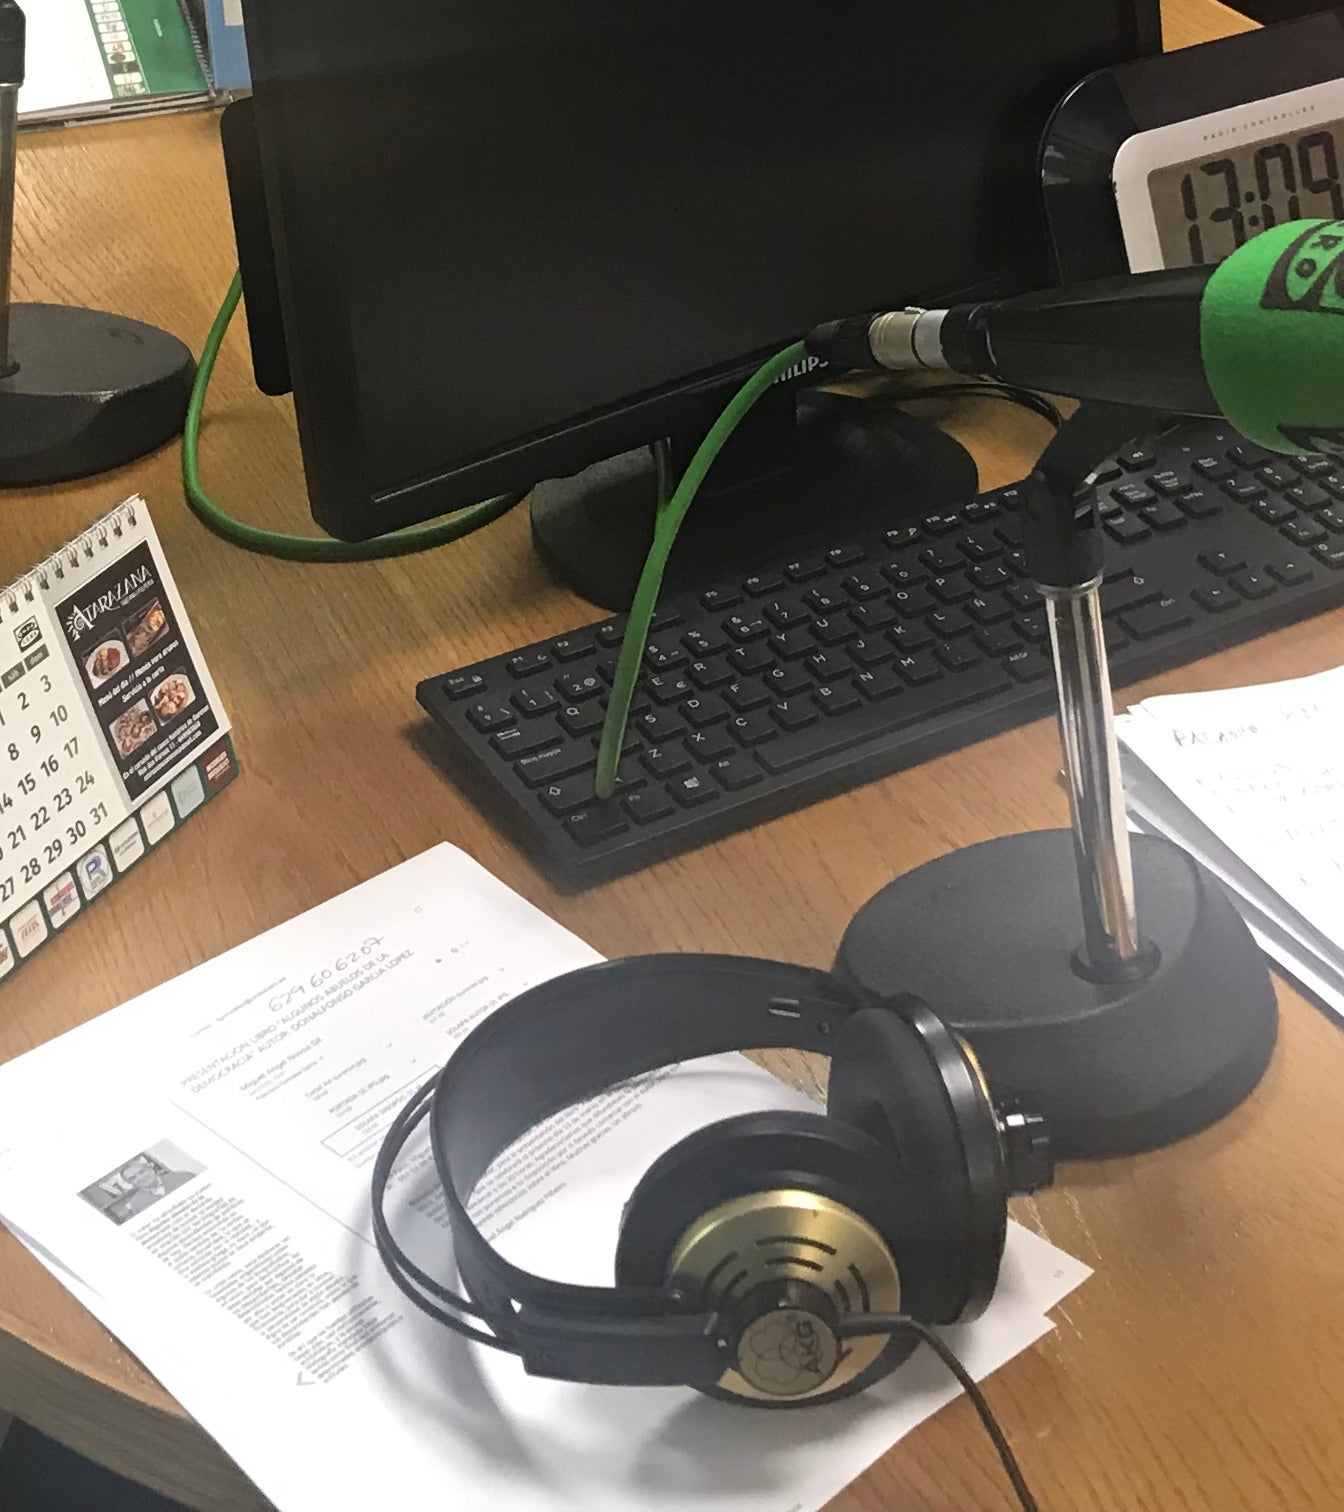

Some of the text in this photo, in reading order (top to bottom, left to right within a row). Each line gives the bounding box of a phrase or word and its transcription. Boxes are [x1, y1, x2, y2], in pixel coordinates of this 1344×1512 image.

[1243, 104, 1316, 132] CONTROLLED
[1181, 130, 1344, 265] 13:09
[773, 356, 829, 384] HILIP
[69, 565, 152, 639] ATARAZANA
[18, 693, 29, 710] 2
[40, 675, 51, 692] 3
[8, 743, 19, 760] 8
[31, 725, 41, 743] 9
[50, 705, 67, 726] 10
[18, 773, 35, 795] 15
[41, 755, 58, 776] 16
[64, 737, 78, 758] 17
[8, 825, 26, 849] 21
[31, 807, 50, 830] 22
[53, 788, 72, 812] 23
[76, 771, 94, 793] 24
[20, 858, 41, 883] 28
[44, 839, 62, 864] 29
[66, 820, 86, 844] 30
[90, 802, 107, 825] 31
[796, 1319, 823, 1375] AKG
